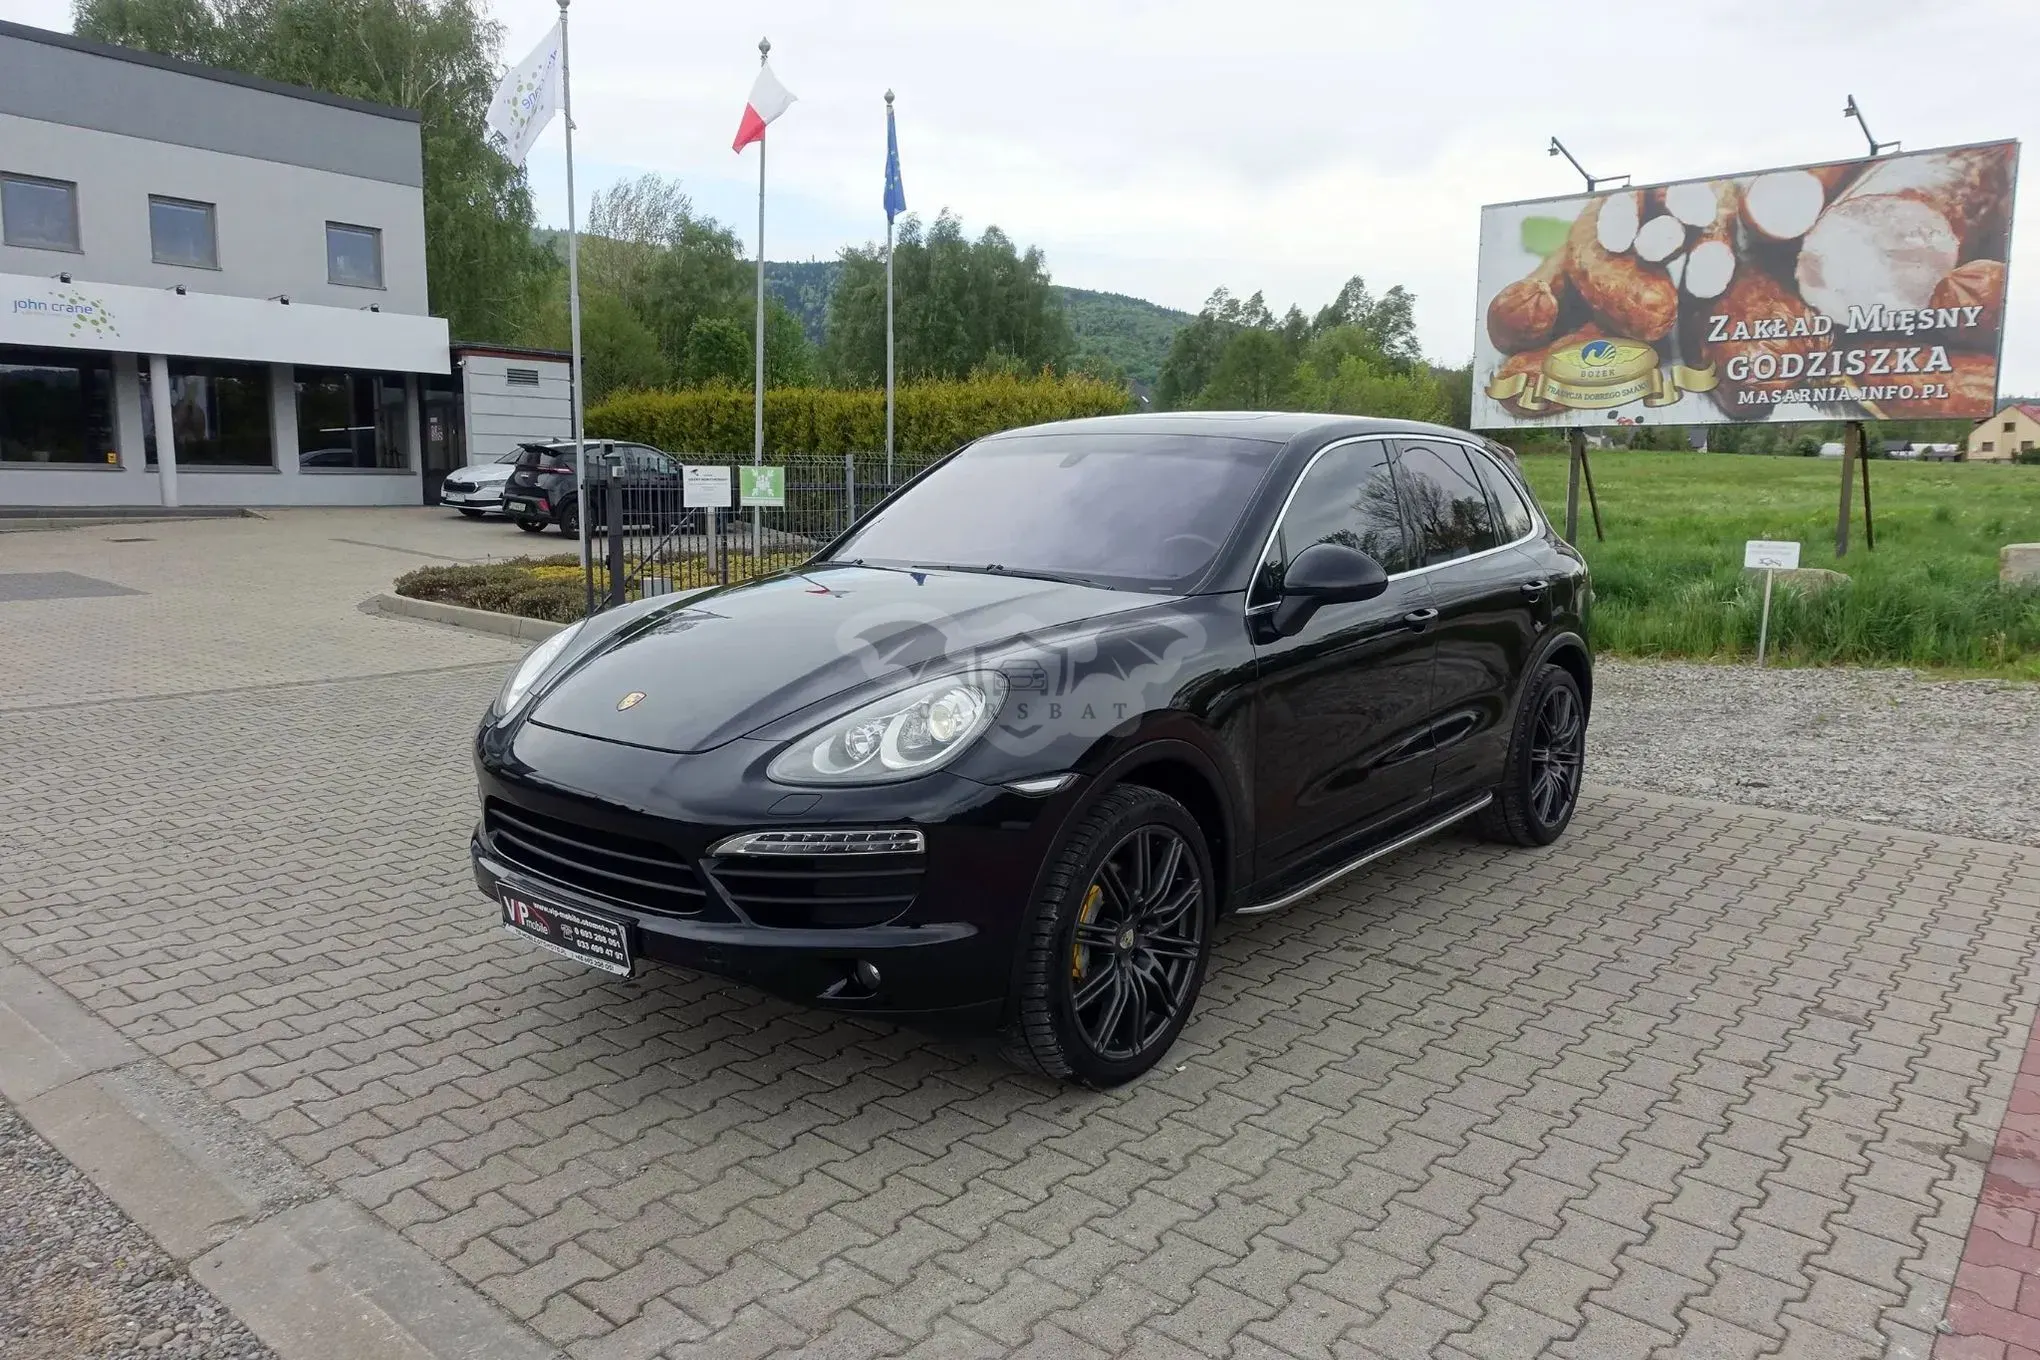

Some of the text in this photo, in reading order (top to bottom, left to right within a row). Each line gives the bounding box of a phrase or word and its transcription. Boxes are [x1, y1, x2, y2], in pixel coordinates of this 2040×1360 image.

[13, 299, 47, 314] john
[51, 303, 93, 315] crane
[1726, 345, 1953, 382] GODZISZKA
[1547, 385, 1583, 400] TRADYCJA
[1584, 391, 1621, 401] DOBREGO
[1738, 384, 1949, 405] MASARNIA.INFO.PL
[526, 919, 549, 935] mobile
